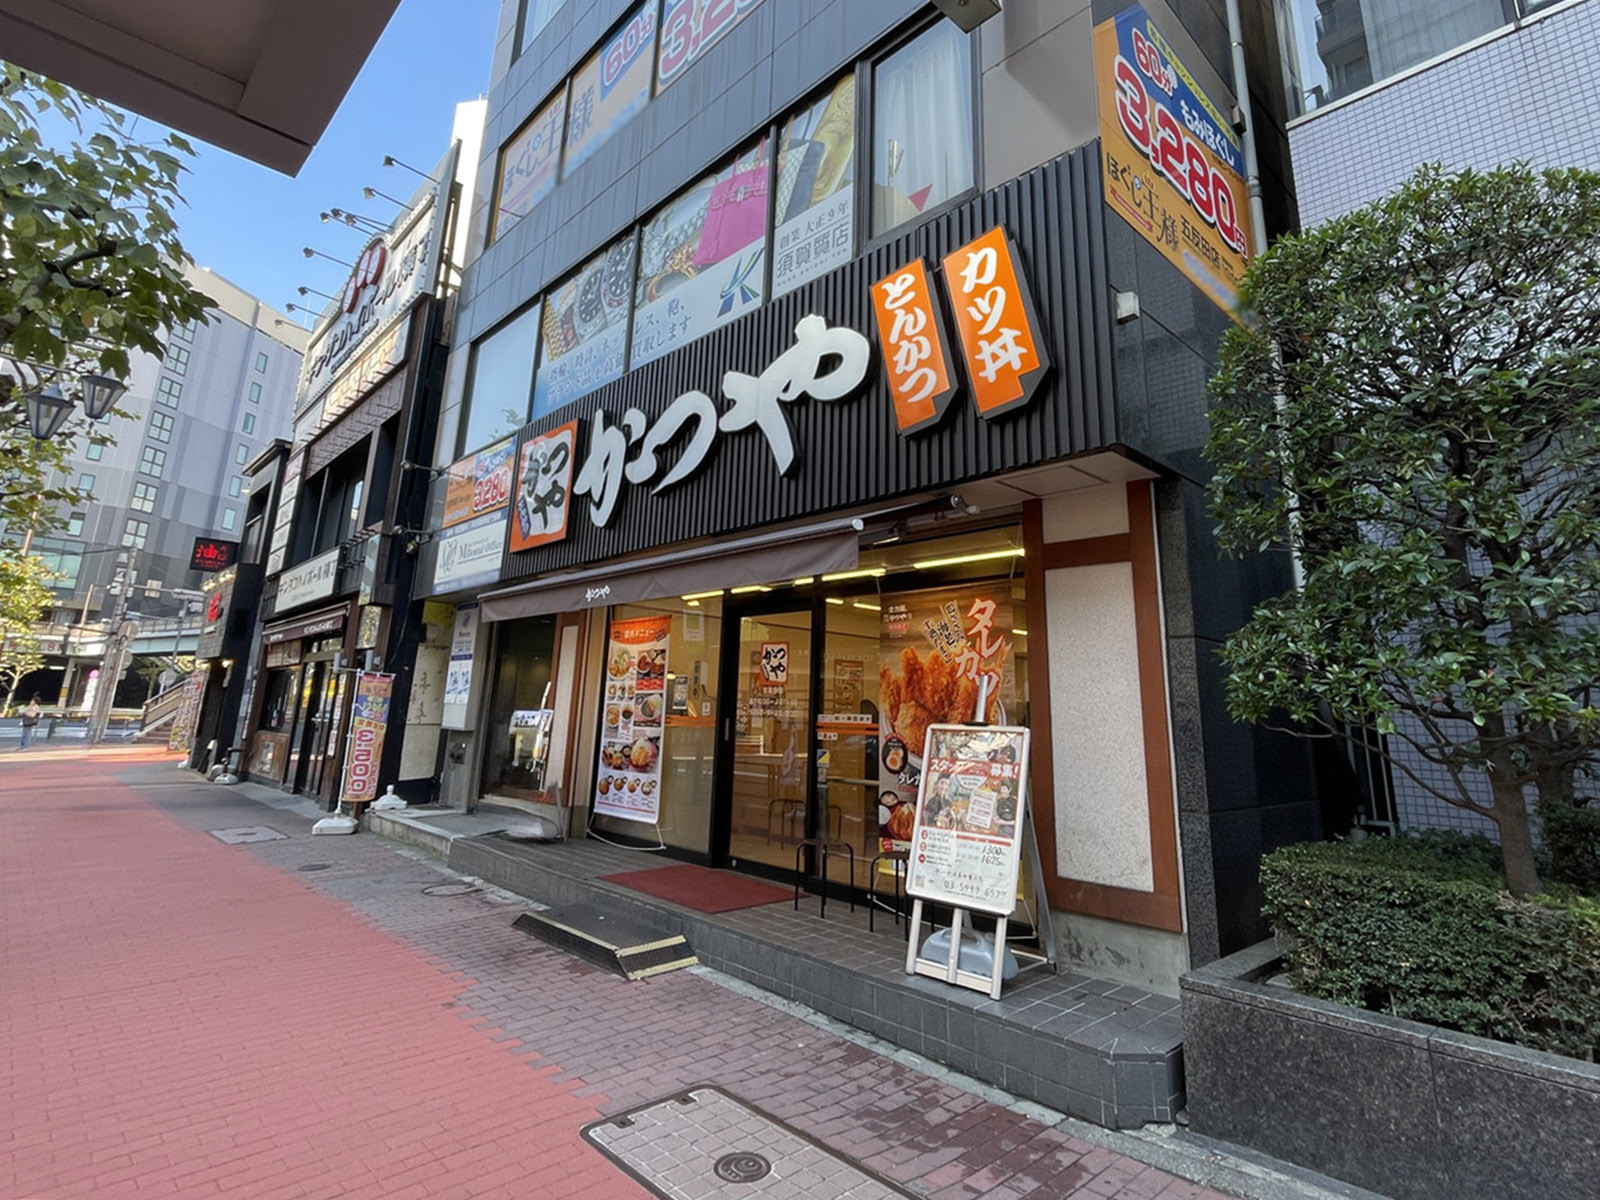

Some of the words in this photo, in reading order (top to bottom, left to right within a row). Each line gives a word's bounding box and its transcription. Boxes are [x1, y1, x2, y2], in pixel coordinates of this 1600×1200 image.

[1132, 27, 1175, 98] 60分
[1180, 99, 1235, 167] もみほぐし
[777, 221, 849, 279] 須賀質店
[1180, 213, 1222, 271] 五反田店
[881, 273, 938, 403] とんかつ
[959, 247, 1028, 383] カツ丼
[573, 313, 871, 528] かつや
[521, 441, 569, 530] かつや
[586, 585, 610, 602] かつや
[763, 647, 786, 679] かつや
